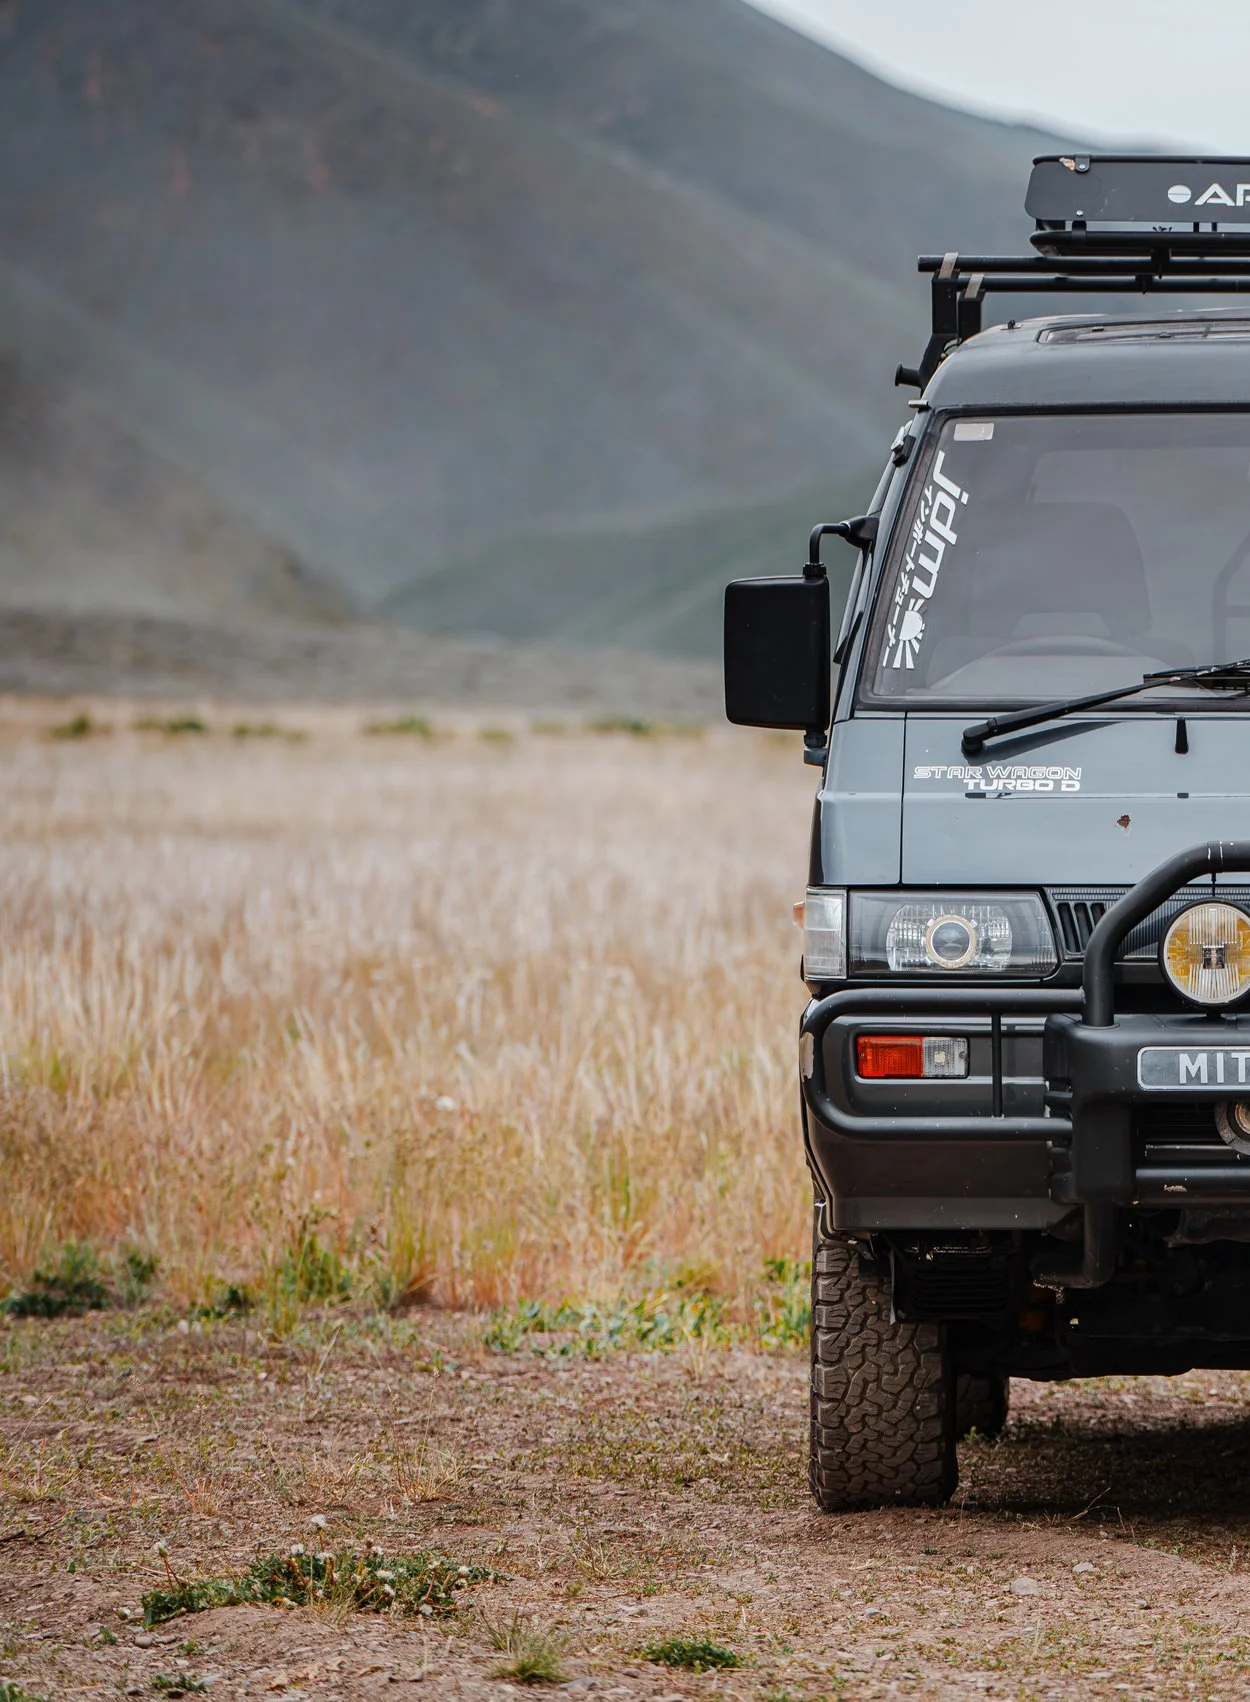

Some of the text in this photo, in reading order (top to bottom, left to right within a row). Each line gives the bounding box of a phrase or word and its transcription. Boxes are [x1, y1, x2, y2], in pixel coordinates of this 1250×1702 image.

[913, 765, 1082, 780] STAR WAGON
[963, 778, 1081, 792] TURBO D
